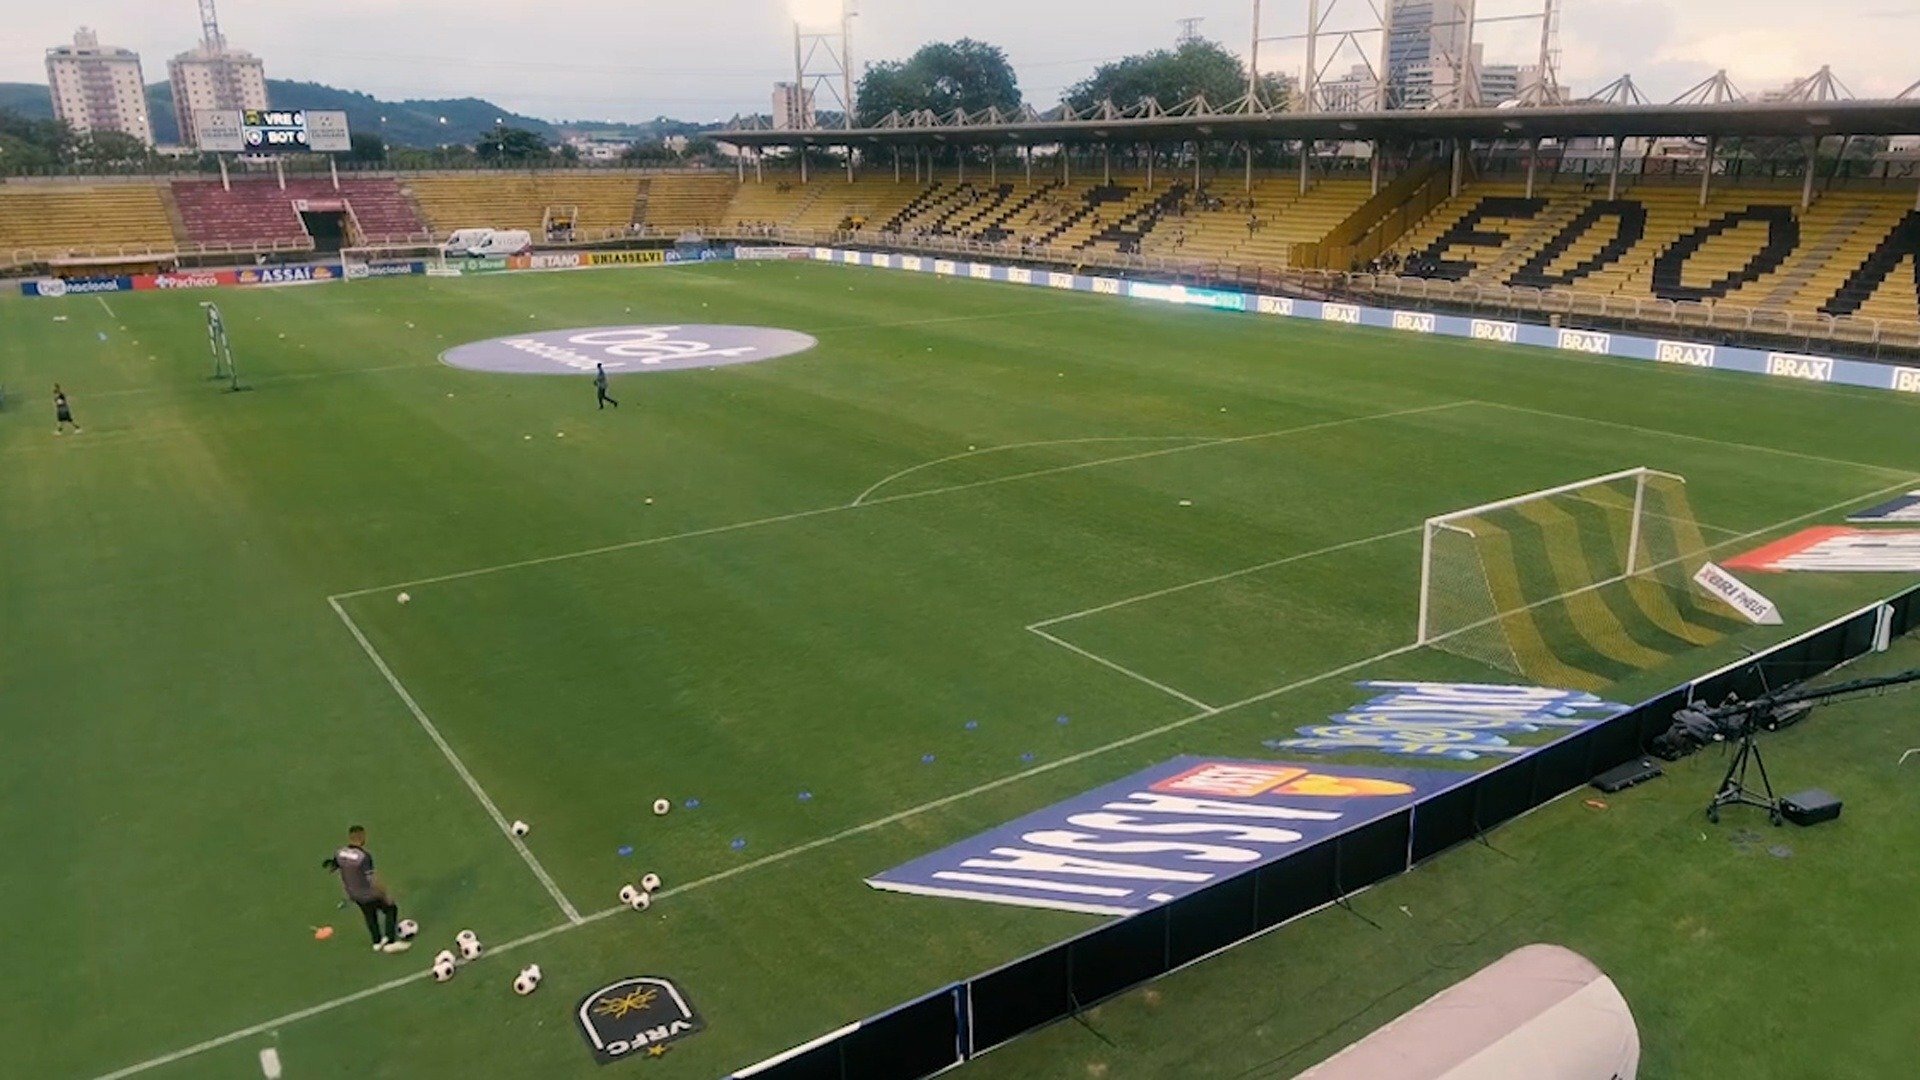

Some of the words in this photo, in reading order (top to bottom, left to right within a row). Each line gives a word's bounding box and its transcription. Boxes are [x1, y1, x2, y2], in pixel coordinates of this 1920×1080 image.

[267, 131, 294, 143] BOT
[531, 253, 580, 268] BETANO
[592, 251, 662, 265] UNIASSELVI
[1397, 316, 1431, 333] BRAX
[1475, 323, 1513, 342] BRAX
[1562, 333, 1606, 354] BRAX
[1661, 345, 1708, 368] BRAX
[1773, 357, 1827, 382] BRAX
[605, 1019, 693, 1056] VRFC
